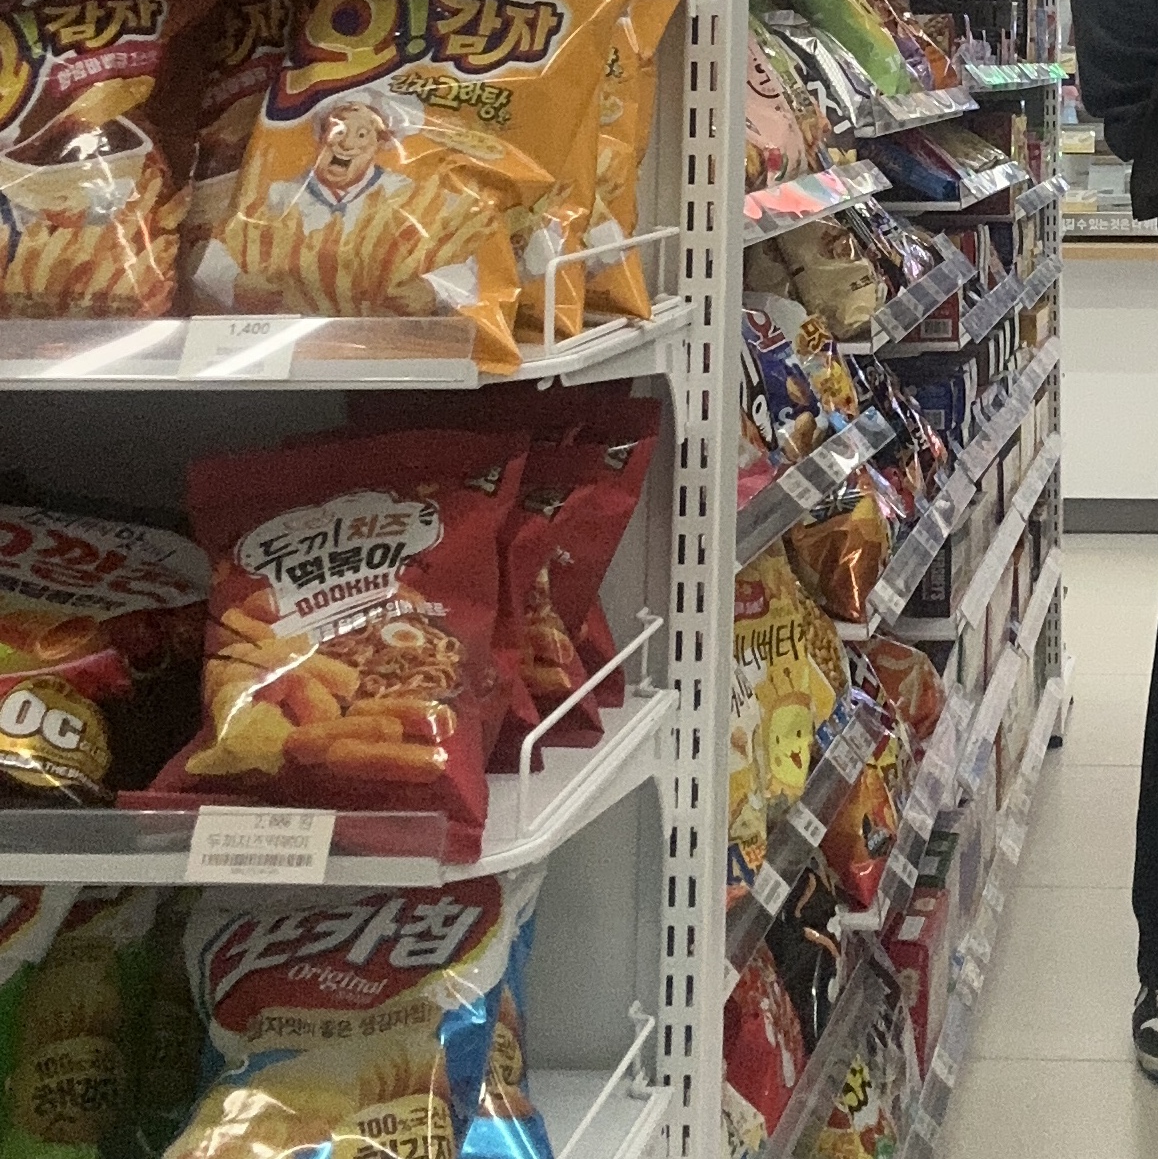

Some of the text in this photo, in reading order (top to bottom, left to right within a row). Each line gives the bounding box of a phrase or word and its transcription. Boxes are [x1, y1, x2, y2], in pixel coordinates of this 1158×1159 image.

[228, 322, 271, 336] 1,400
[254, 517, 343, 582] 두끼
[347, 513, 413, 541] 치즈
[285, 542, 406, 589] 떡볶이
[295, 572, 390, 618] DOOKKI
[214, 896, 484, 1002] 포카칩
[287, 962, 389, 995] Original
